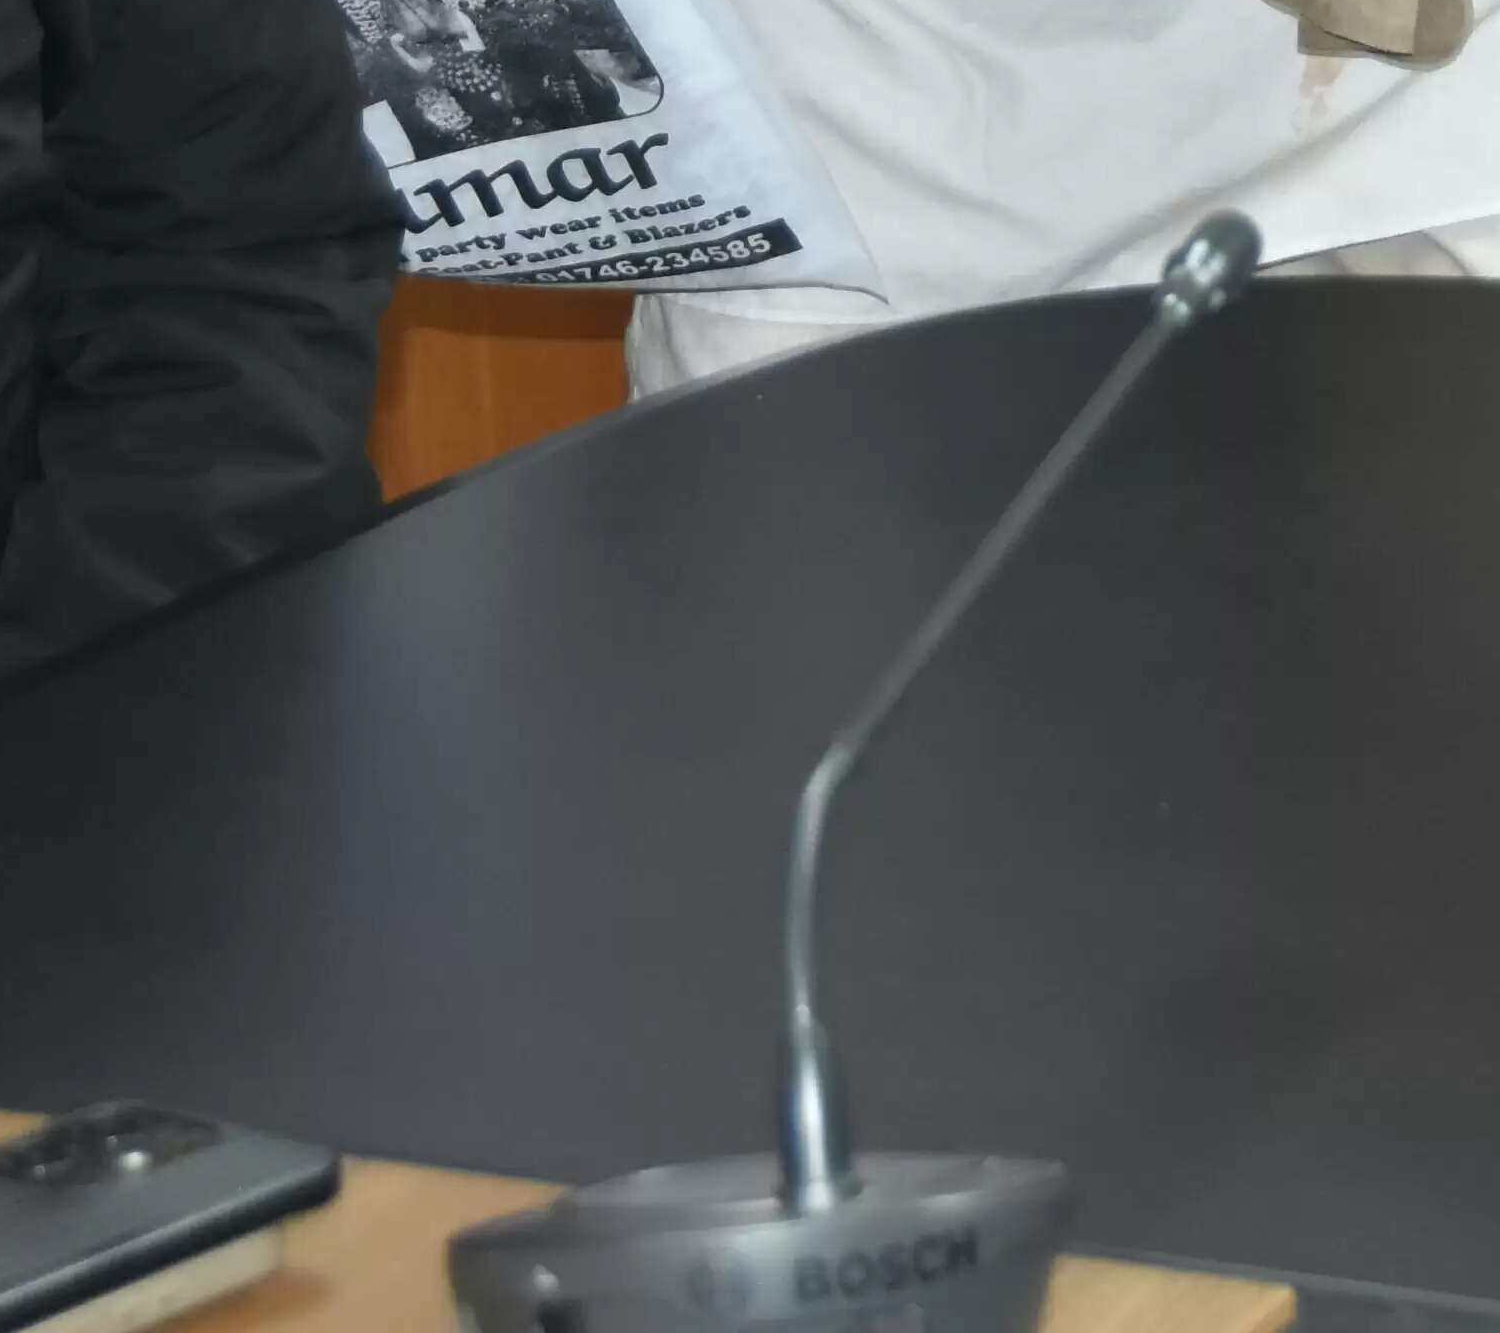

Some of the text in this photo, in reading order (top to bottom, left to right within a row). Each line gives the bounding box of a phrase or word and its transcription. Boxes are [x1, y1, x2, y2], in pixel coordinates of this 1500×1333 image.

[415, 193, 706, 263] party wear items
[535, 232, 771, 283] 01746-234585
[588, 234, 618, 251] &
[623, 205, 752, 245] Blazers
[794, 1227, 979, 1303] BOSCH
